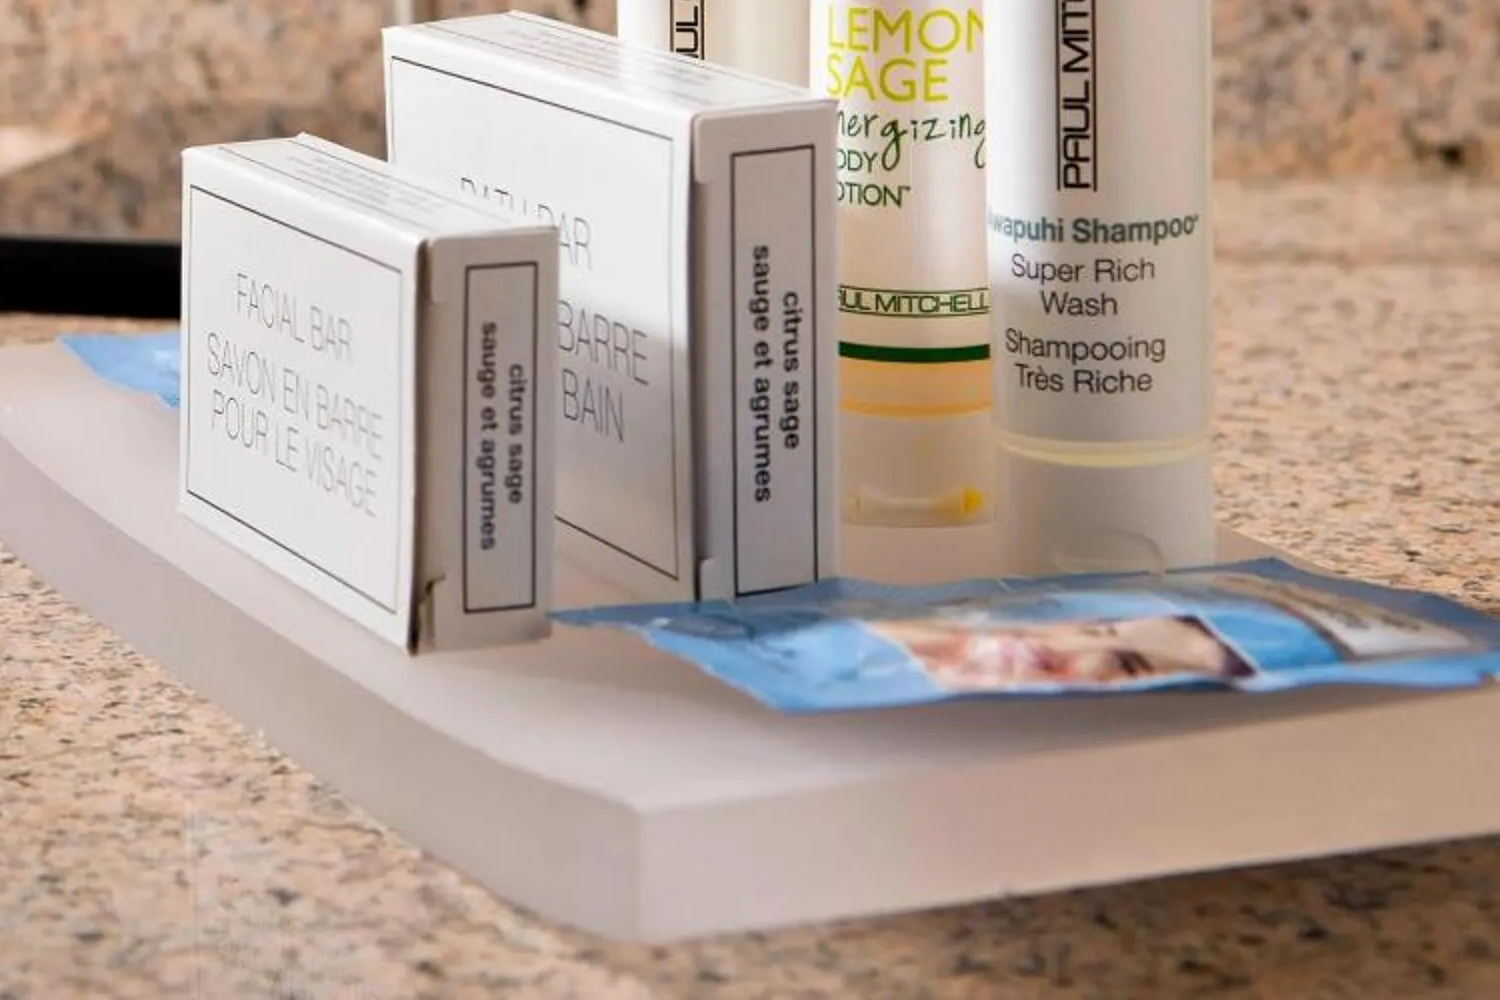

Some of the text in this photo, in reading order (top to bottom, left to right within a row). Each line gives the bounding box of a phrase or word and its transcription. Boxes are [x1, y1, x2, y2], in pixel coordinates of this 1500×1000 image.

[676, 5, 698, 58] UL
[827, 53, 948, 102] SAGE
[837, 110, 985, 171] nergizing
[1062, 80, 1090, 190] PAUL
[989, 213, 1064, 243] wapuhi
[839, 289, 991, 313] UL MITCHELL
[1011, 253, 1156, 285] Super Rich
[1040, 290, 1118, 316] Wash
[237, 272, 353, 362] FACIAL BAR
[558, 299, 649, 387] BARRE
[1005, 328, 1166, 365] Shampooing
[207, 332, 383, 460] SAVON EN BARRE
[563, 367, 625, 443] BAIN
[750, 245, 773, 502] sauge et agrumes
[779, 291, 803, 449] citrus sage
[1014, 362, 1152, 394] Très Riche
[211, 389, 377, 518] POUR LE VISAGE
[476, 321, 498, 550] sauge et agrumes
[504, 363, 527, 504] citrus sage
